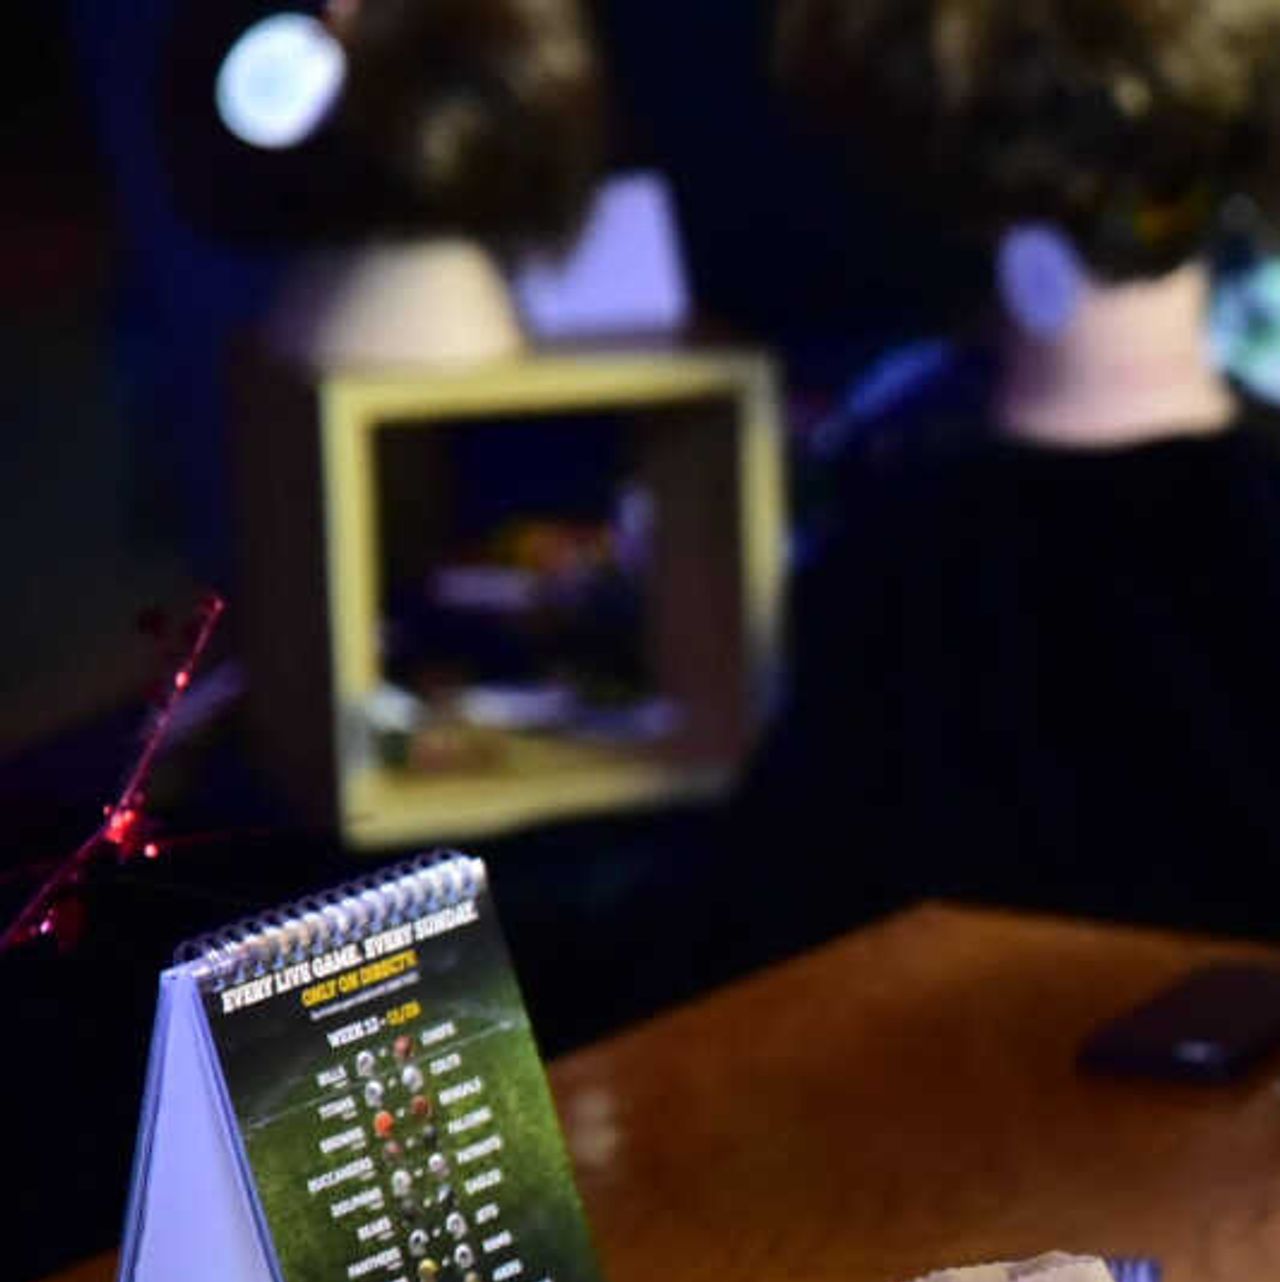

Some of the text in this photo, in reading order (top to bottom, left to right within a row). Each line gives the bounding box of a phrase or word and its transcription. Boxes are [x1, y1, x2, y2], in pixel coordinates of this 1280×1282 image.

[220, 976, 274, 1014] EVERY
[275, 962, 312, 991] LIVE
[364, 924, 413, 957] EVERY
